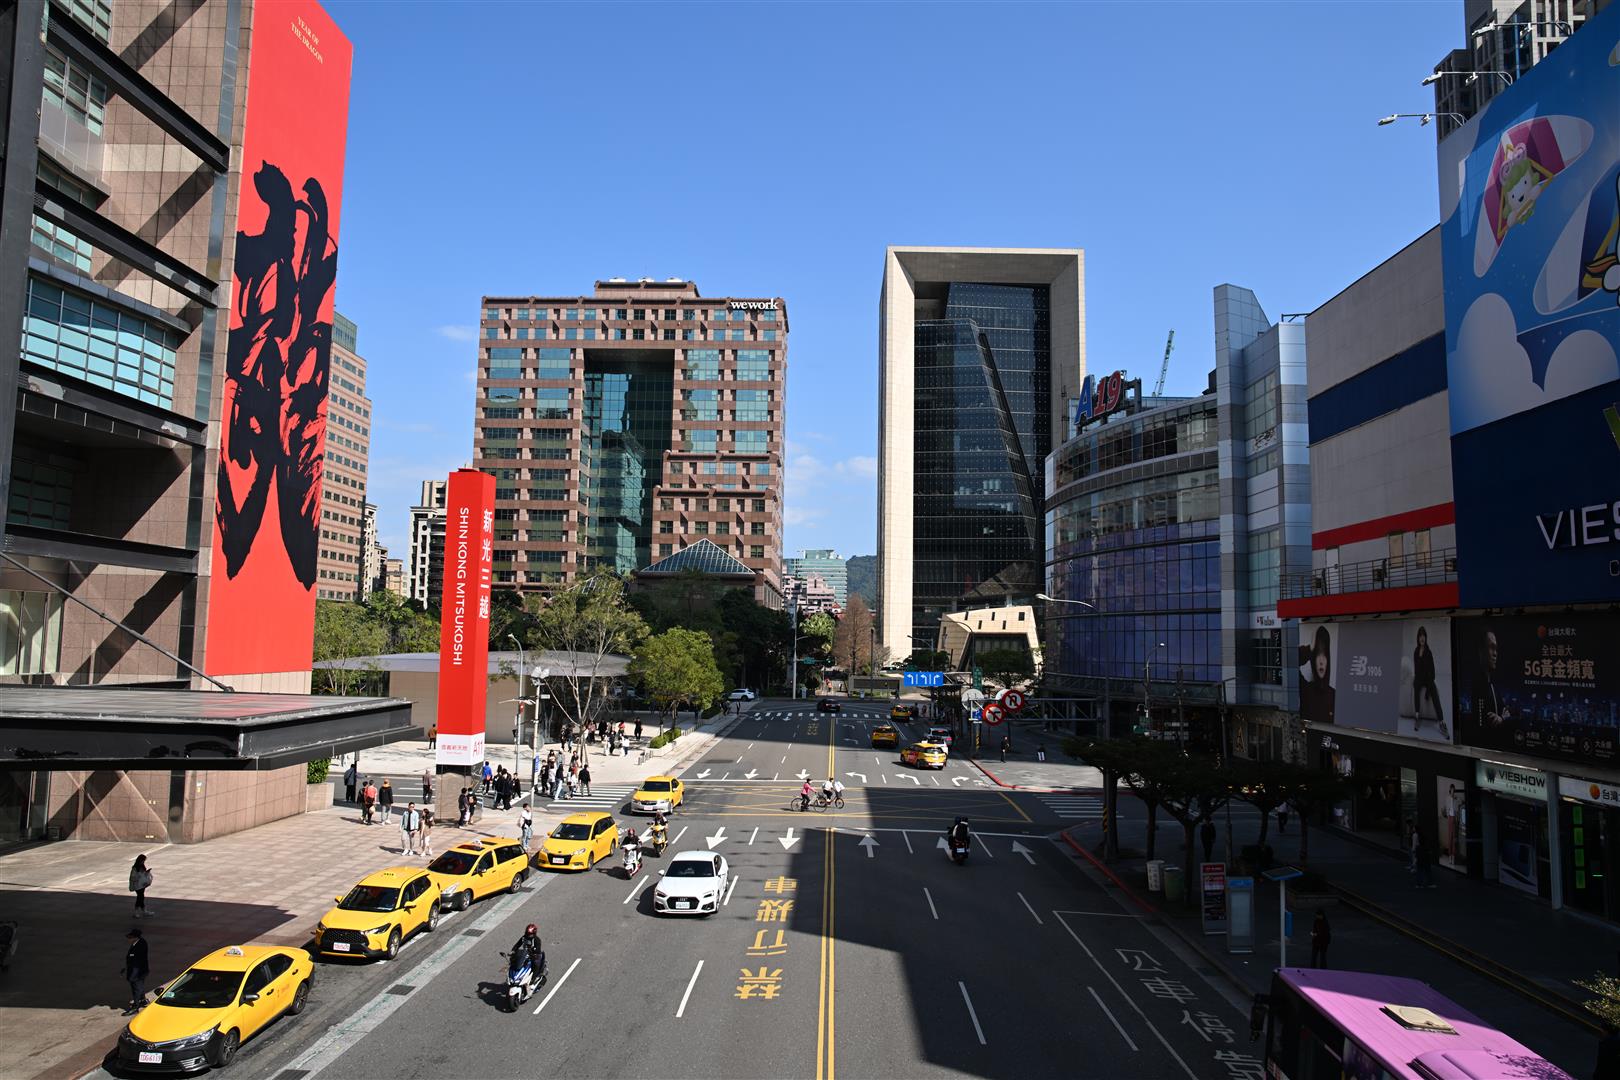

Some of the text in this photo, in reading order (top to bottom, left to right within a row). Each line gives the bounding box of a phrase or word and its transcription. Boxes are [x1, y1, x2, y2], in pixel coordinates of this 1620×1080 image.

[297, 15, 311, 38] YEAR
[291, 22, 323, 65] THE DRAGON
[731, 298, 779, 310] wework
[1074, 370, 1123, 425] A19
[479, 508, 493, 620] 新光三越
[453, 507, 469, 665] SHIN KONG MITSUKOSHI
[1524, 658, 1595, 680] 5G黃金頻寬
[473, 740, 483, 758] A11
[1499, 769, 1545, 787] VIESHOW
[735, 876, 798, 1000] 禁行機車
